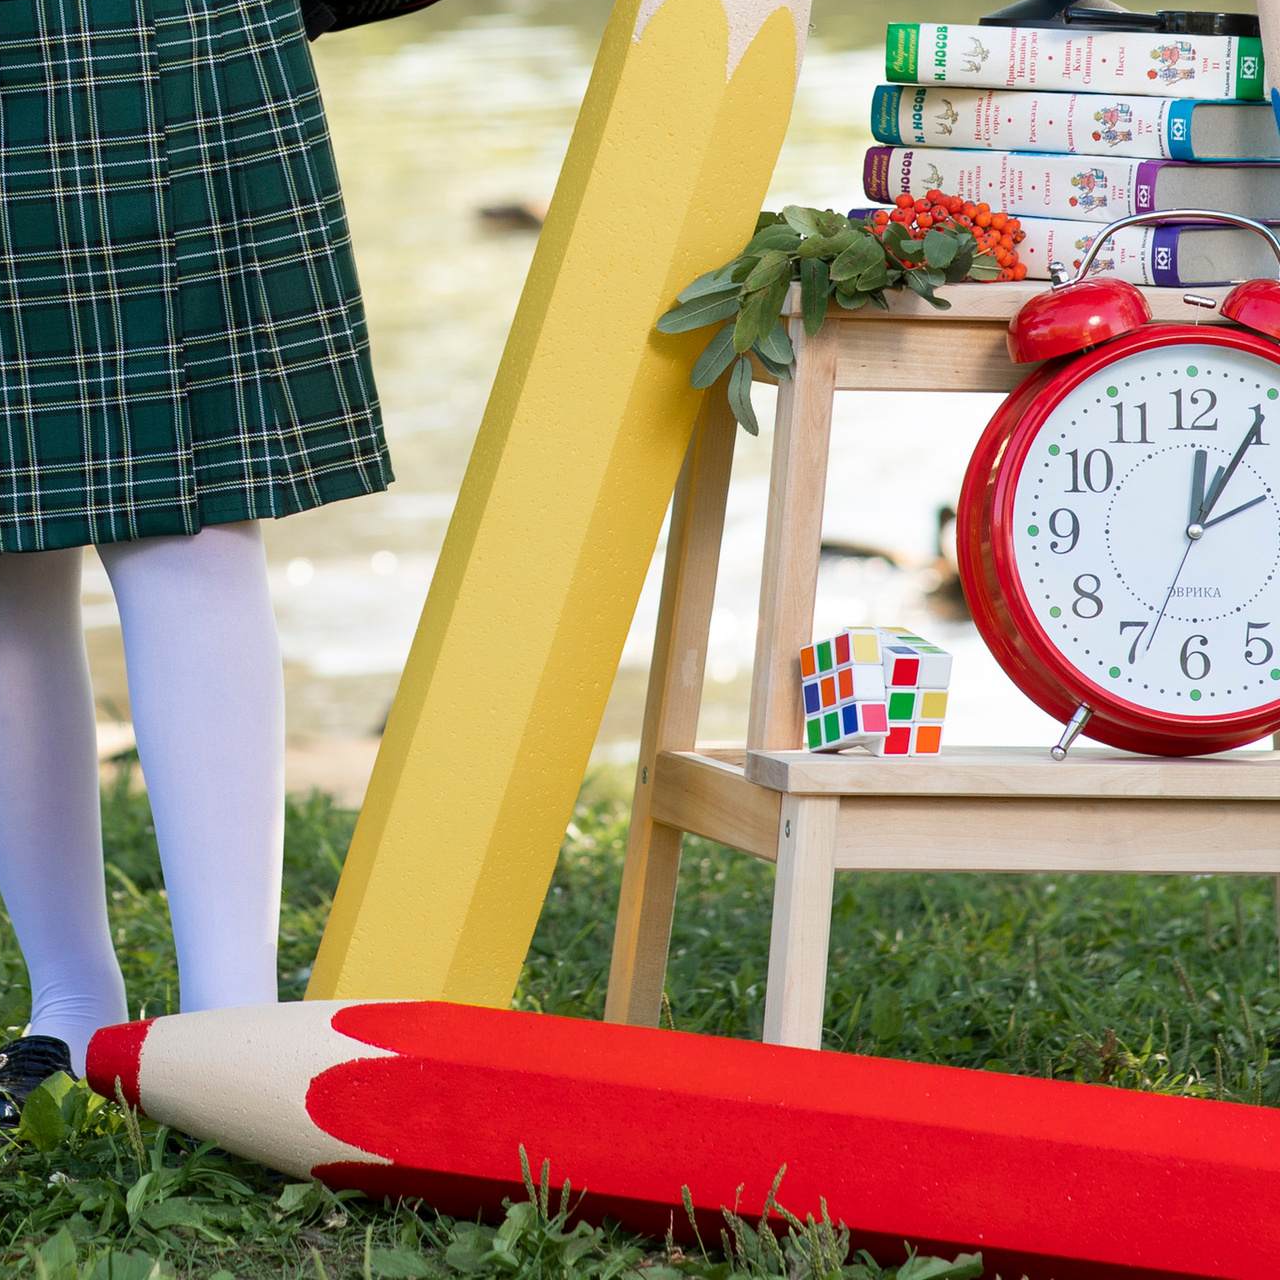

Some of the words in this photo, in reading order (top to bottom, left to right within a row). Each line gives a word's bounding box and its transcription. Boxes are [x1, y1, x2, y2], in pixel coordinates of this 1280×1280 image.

[934, 26, 948, 68] НОСОВ
[1017, 36, 1027, 78] Незнайки
[1062, 40, 1072, 79] Дневник
[1073, 48, 1081, 71] Коли
[1082, 36, 1093, 84] Синицына
[1116, 47, 1125, 76] Пьесы
[912, 88, 927, 131] НОСОВ
[975, 97, 984, 140] Незнайка
[983, 91, 994, 141] Солнечном
[1029, 101, 1038, 143] Рассказы
[901, 151, 914, 194] НОСОВ
[1109, 401, 1155, 443] 11
[1168, 388, 1218, 430] 12
[1248, 404, 1270, 445] 1
[1064, 448, 1114, 493] 10
[1049, 508, 1080, 554] 9
[1072, 574, 1103, 618] 8
[1167, 586, 1221, 598] ЭВРИКА
[1120, 621, 1149, 665] 7
[1180, 634, 1211, 680] 6
[1244, 621, 1273, 665] 5
